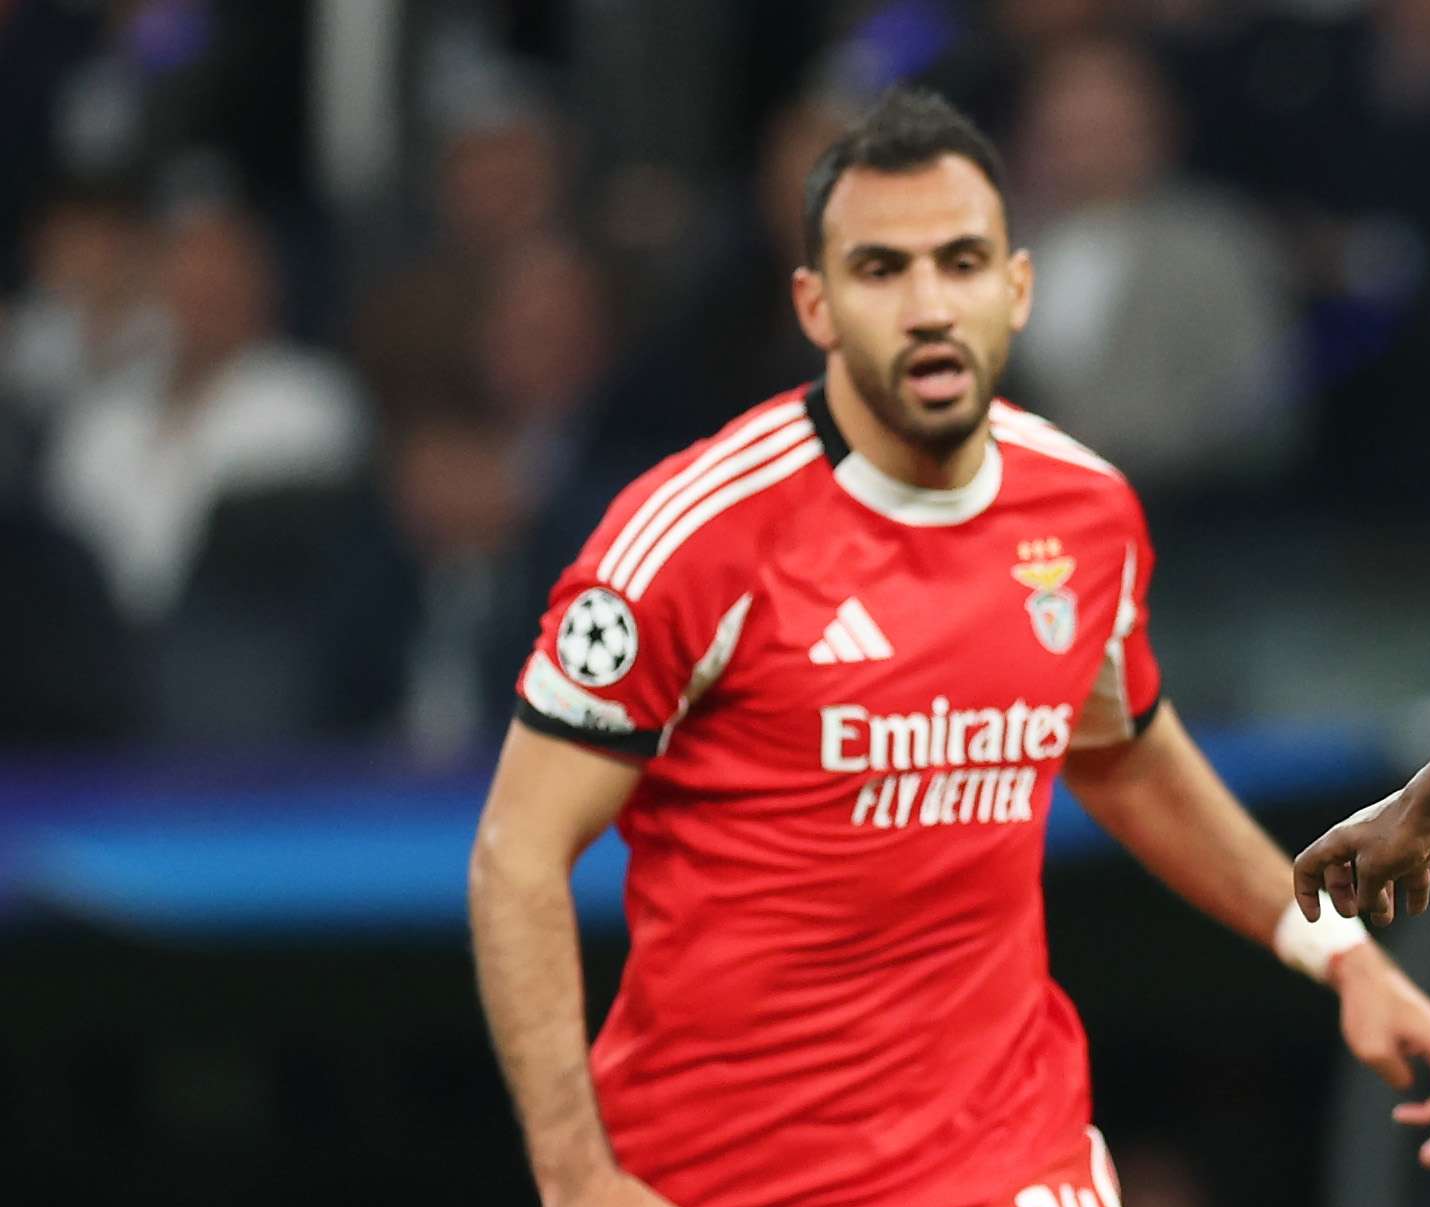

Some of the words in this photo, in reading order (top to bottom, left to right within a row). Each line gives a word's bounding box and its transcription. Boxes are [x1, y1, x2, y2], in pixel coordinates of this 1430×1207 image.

[820, 695, 1074, 773] Emirates
[851, 775, 921, 828] FLY
[919, 766, 1037, 826] BETTER
